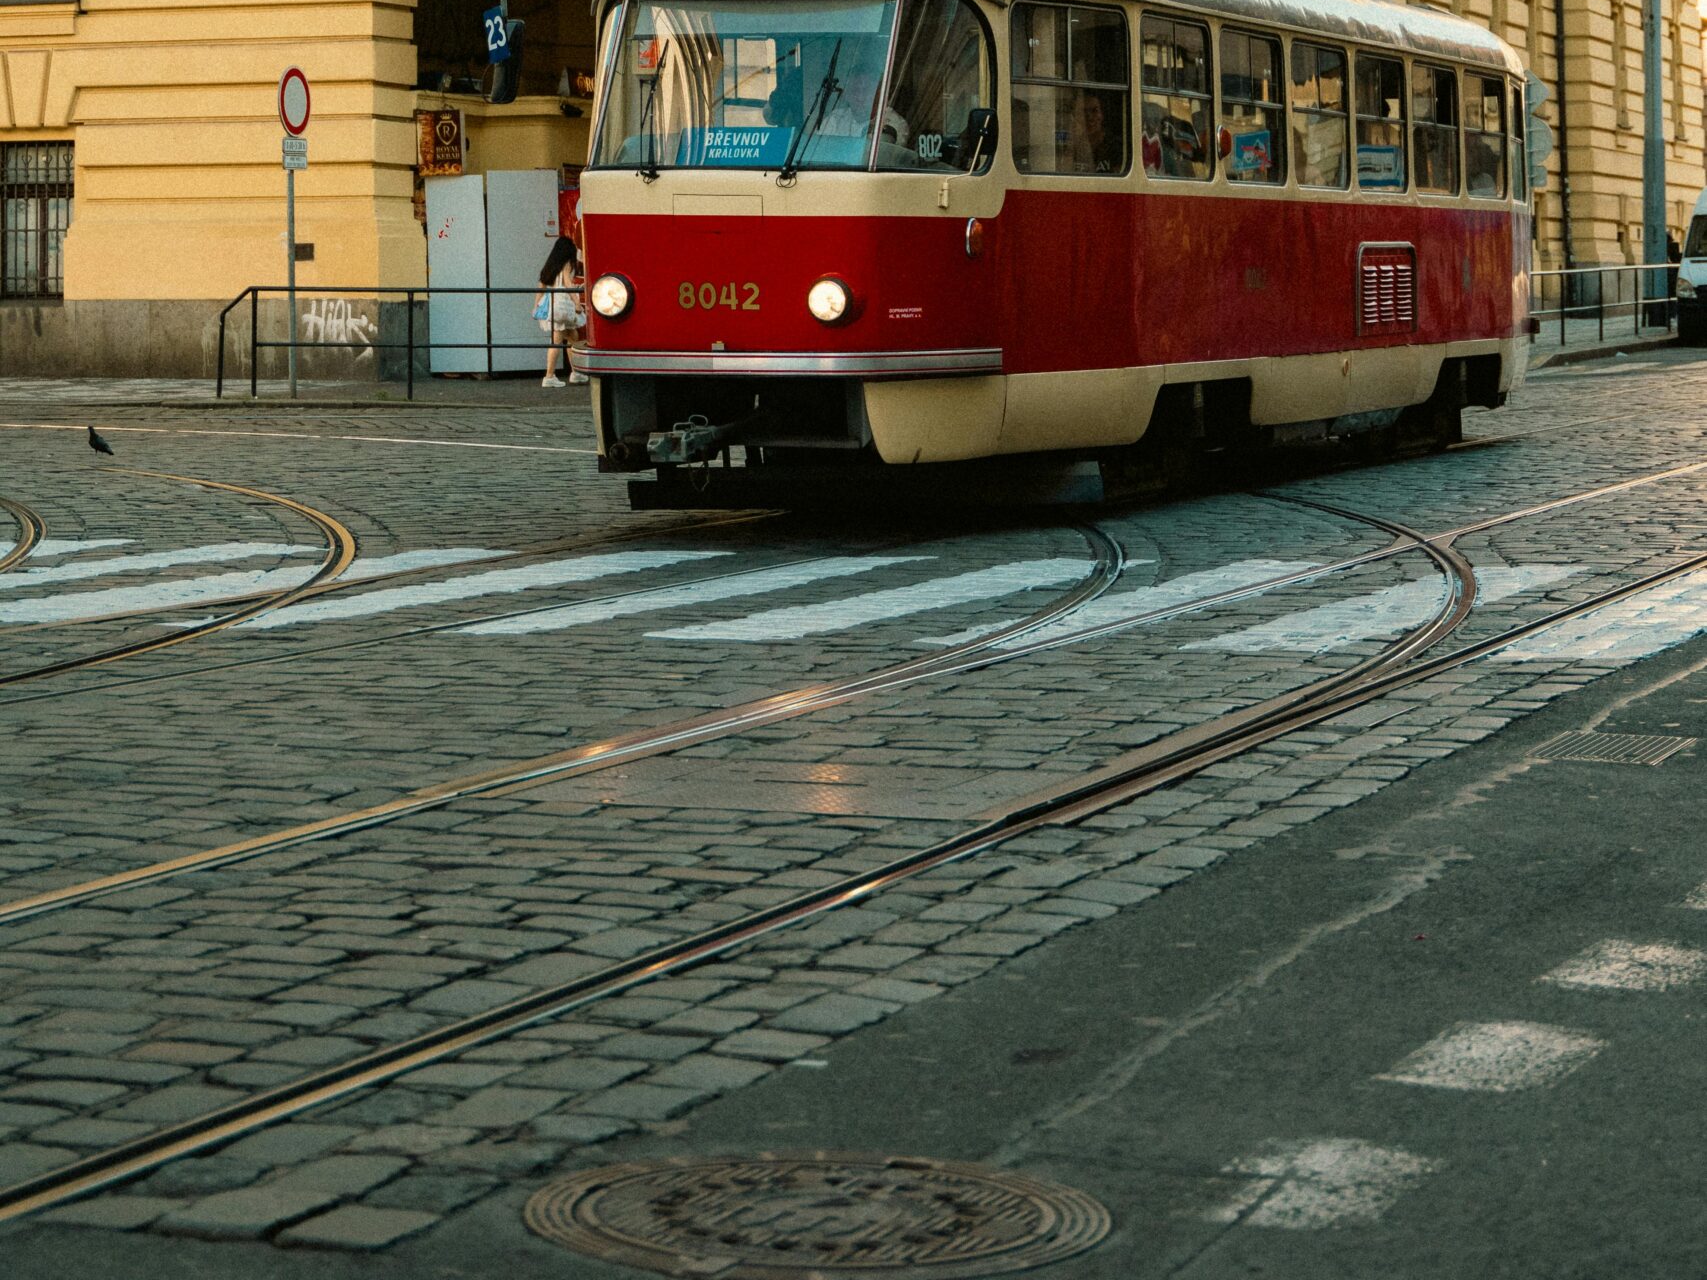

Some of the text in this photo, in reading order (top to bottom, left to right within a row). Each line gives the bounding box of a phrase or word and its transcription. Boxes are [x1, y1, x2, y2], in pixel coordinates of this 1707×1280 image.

[485, 15, 507, 51] 23
[706, 129, 770, 146] BŘEVNOV
[918, 134, 943, 158] 802
[436, 145, 459, 153] ROYAL
[708, 147, 760, 158] KRÁLOVKA
[679, 282, 760, 310] 8042
